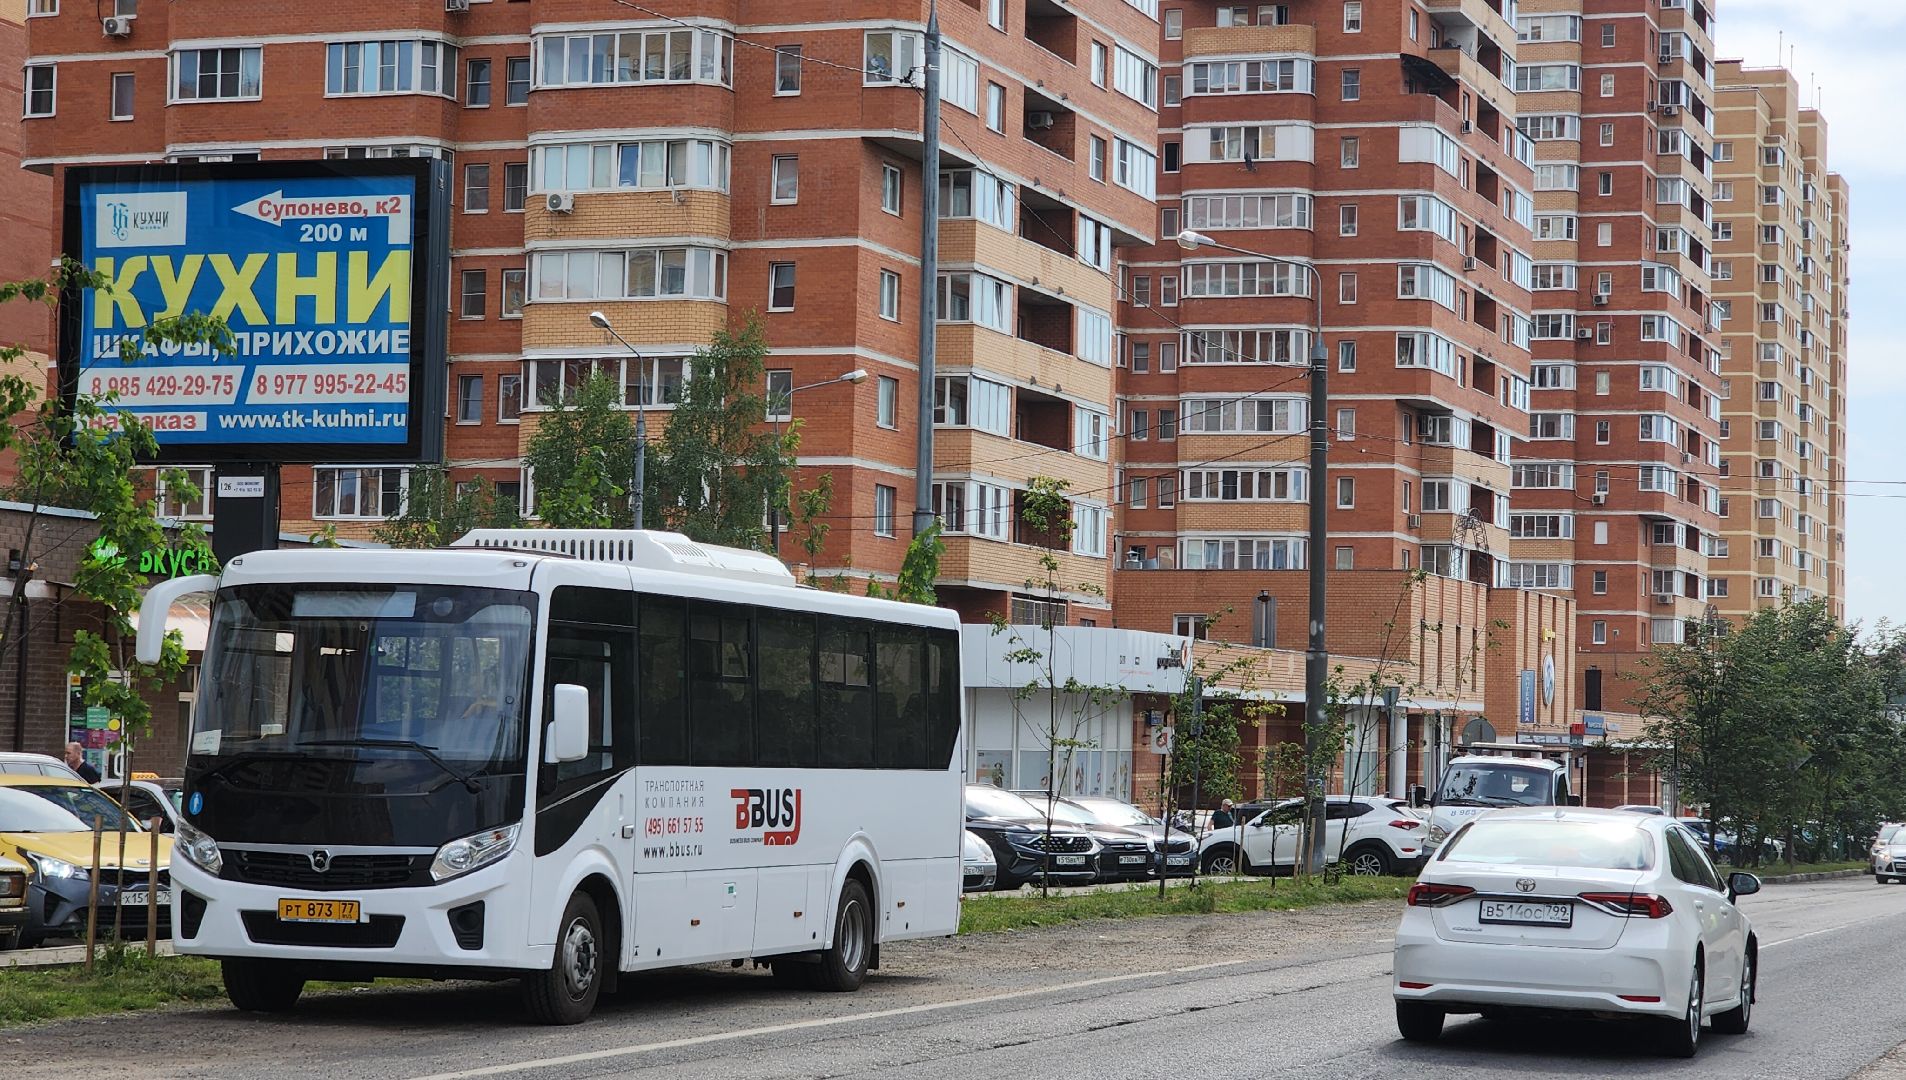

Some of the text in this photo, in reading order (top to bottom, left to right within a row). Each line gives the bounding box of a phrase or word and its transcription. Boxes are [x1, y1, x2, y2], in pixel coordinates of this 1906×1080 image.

[258, 197, 401, 221] Супонево, к2
[133, 211, 169, 229] КУХНИ
[300, 223, 367, 243] 200 м
[93, 249, 411, 329] КУХНИ
[231, 329, 410, 356] ПРИХОЖИЕ
[91, 374, 234, 397] 8 985 429-29-75
[256, 373, 406, 395] 8 977 995-22-45
[140, 414, 197, 430] аказ
[219, 408, 406, 429] www.tk-kuhni.ru
[645, 780, 704, 792] ТРАНСПОРТНАЯ
[645, 796, 704, 808] КОМПАНИЯ
[645, 817, 704, 838] (495) 661 57 55
[643, 841, 703, 858] www.bbus.ru
[124, 892, 162, 904] Х151С
[286, 902, 354, 917] РТ 873 77
